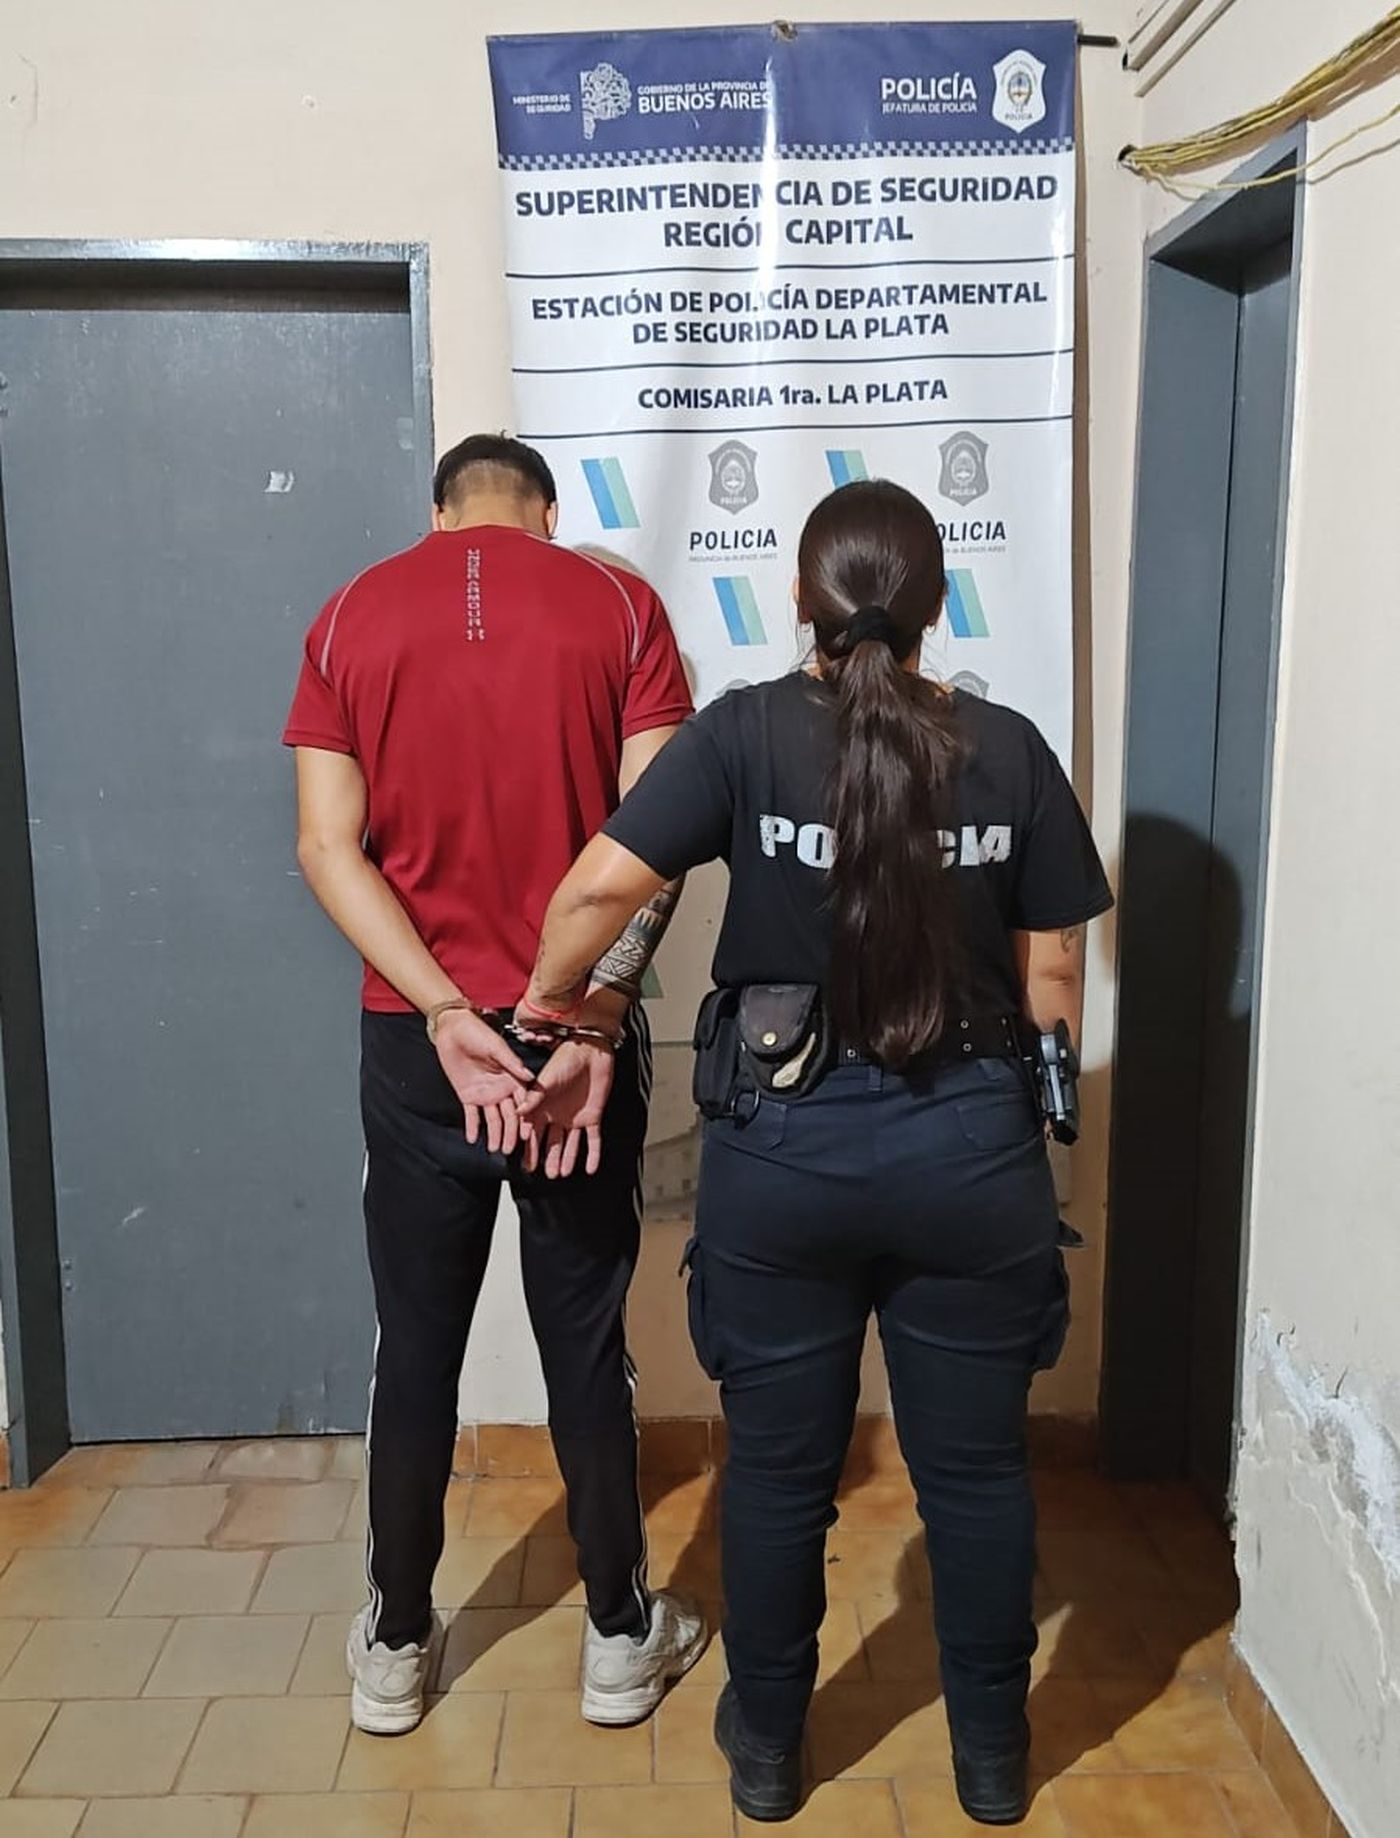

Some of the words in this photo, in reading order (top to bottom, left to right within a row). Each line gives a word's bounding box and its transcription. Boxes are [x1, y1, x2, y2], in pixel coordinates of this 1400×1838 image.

[881, 72, 977, 100] POLICÍA
[639, 92, 716, 114] BUENOS
[720, 91, 773, 109] AIRES
[927, 102, 941, 113] DE
[831, 180, 872, 206] DE
[880, 175, 1059, 203] SEGURIDAD
[663, 216, 763, 248] REGIÓ
[785, 216, 914, 245] CAPITAL
[532, 288, 663, 320] ESTACIÓN
[670, 291, 703, 313] DE
[709, 284, 809, 313] POLCÍA
[815, 282, 1048, 310] DEPARTAMENTAL
[632, 322, 668, 344] DE
[674, 318, 819, 343] SEGURIDAD
[825, 318, 857, 340] LA
[864, 313, 950, 339] PLATA
[637, 386, 773, 409] COMISARIA
[779, 384, 822, 405] 1ra.
[827, 384, 859, 404] LA
[865, 379, 948, 404] PLATA
[689, 528, 778, 551] POLICIA
[936, 520, 1006, 542] OLICIA
[759, 813, 1013, 869] POIA
